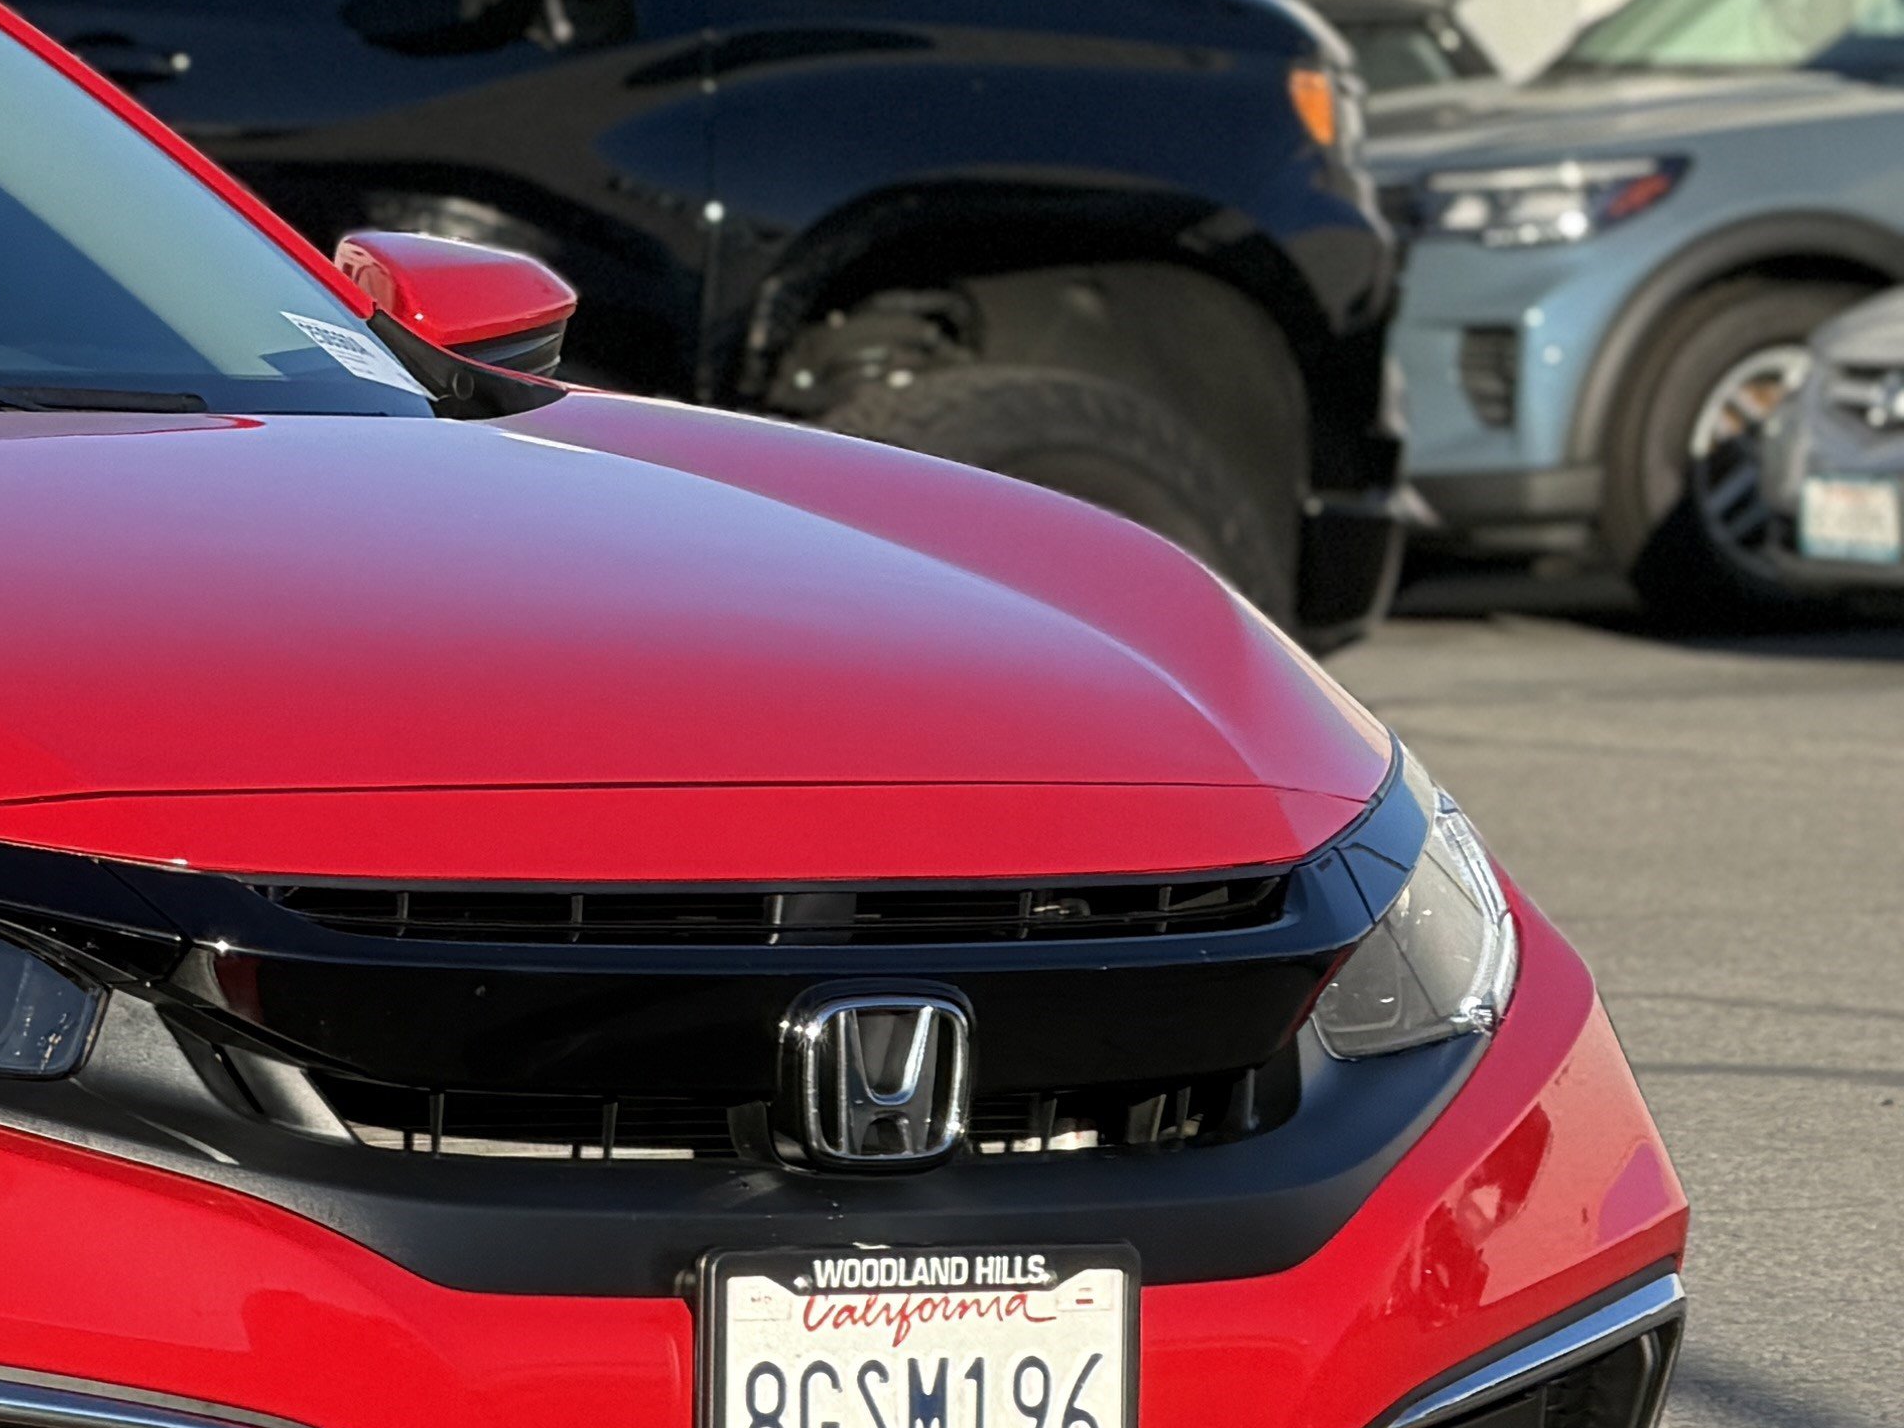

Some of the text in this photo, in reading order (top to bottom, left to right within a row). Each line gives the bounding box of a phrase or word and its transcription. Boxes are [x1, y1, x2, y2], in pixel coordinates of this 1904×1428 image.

[812, 1254, 1048, 1289] WOODLAND HILLS
[803, 1291, 1058, 1349] California
